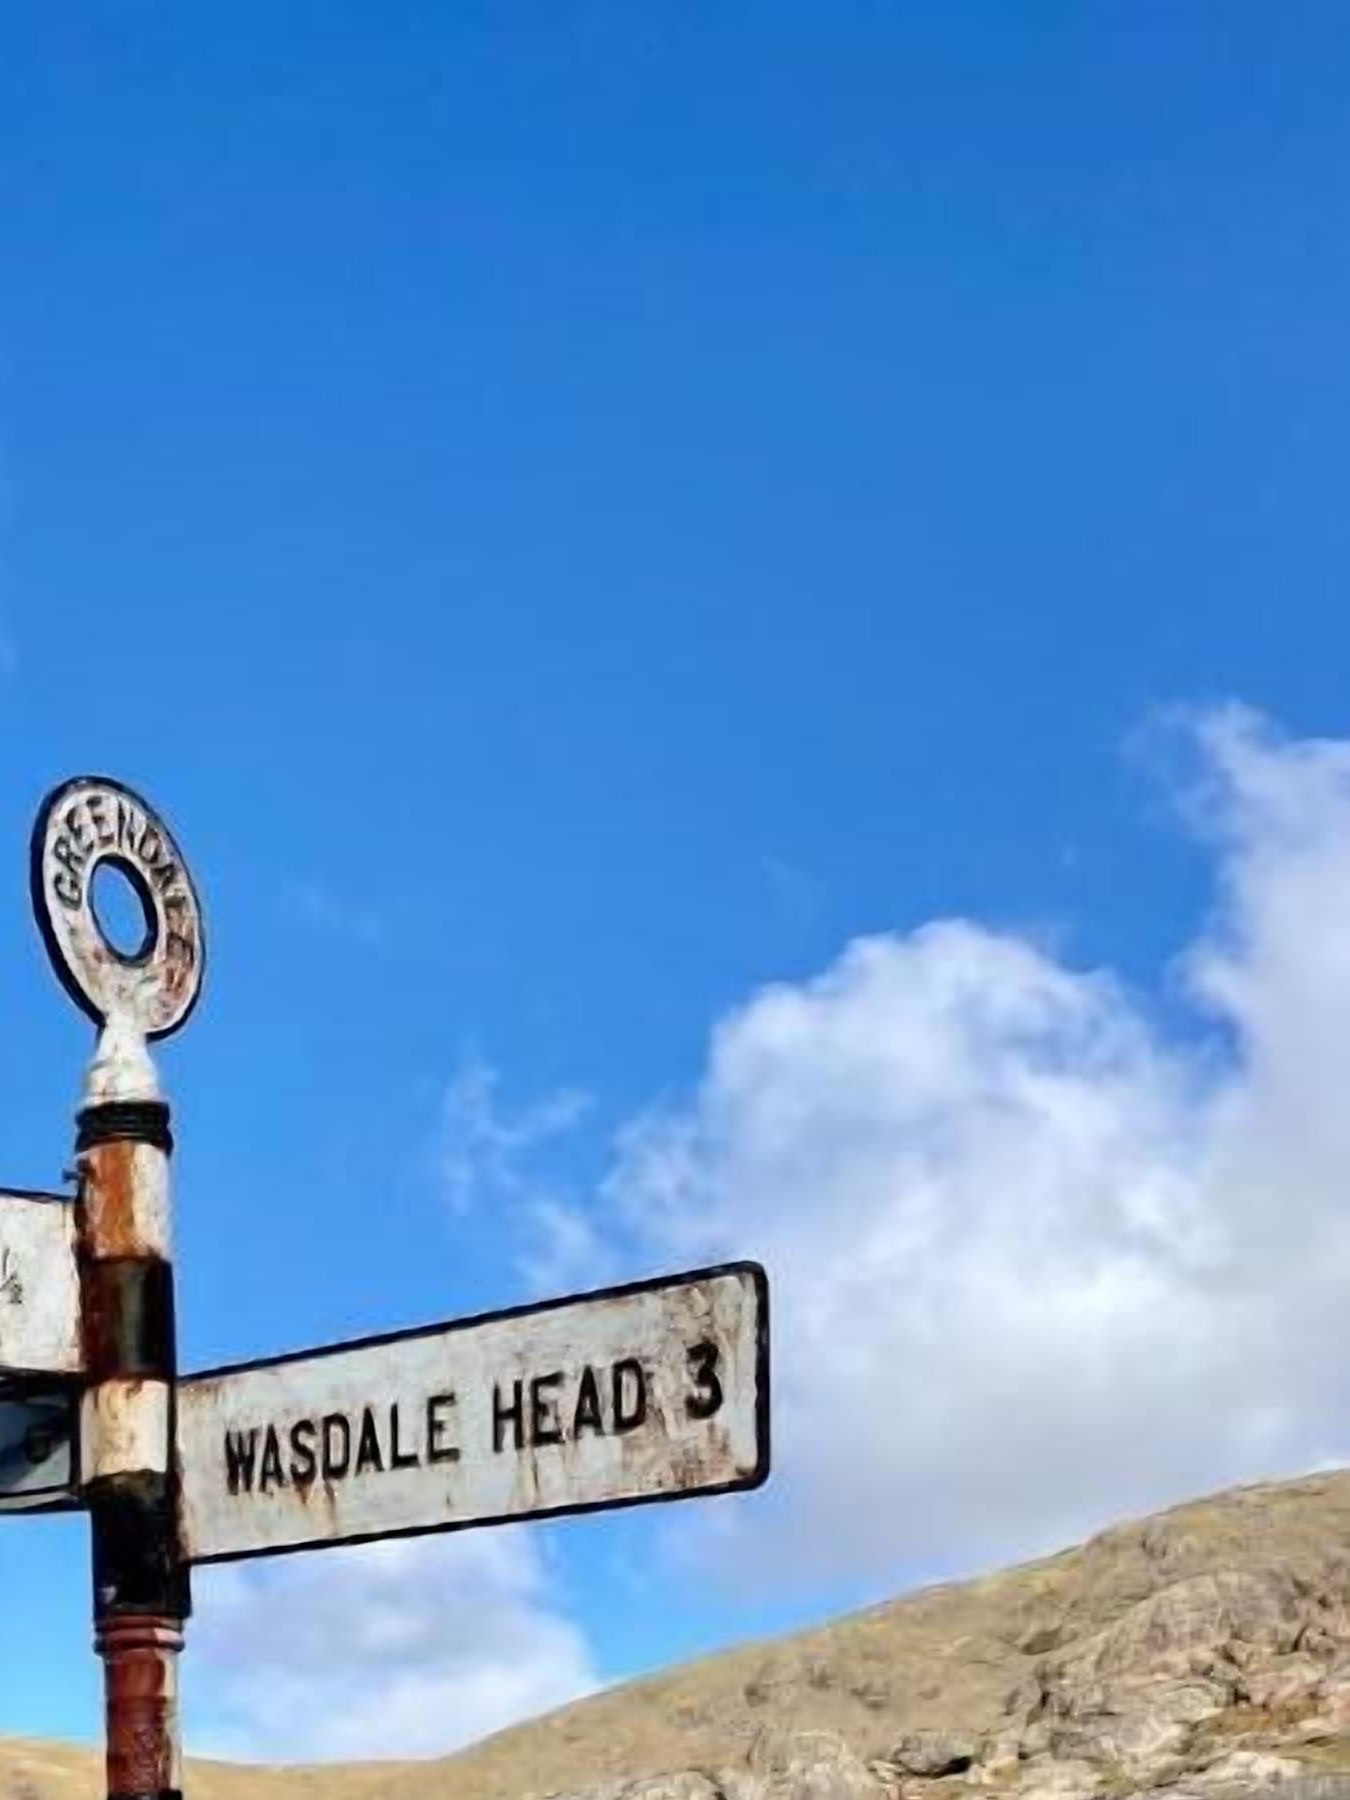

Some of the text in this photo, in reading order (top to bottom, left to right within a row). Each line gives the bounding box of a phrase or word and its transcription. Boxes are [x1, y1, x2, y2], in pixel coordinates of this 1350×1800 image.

[224, 1340, 724, 1496] WASDALE HEAD 3
